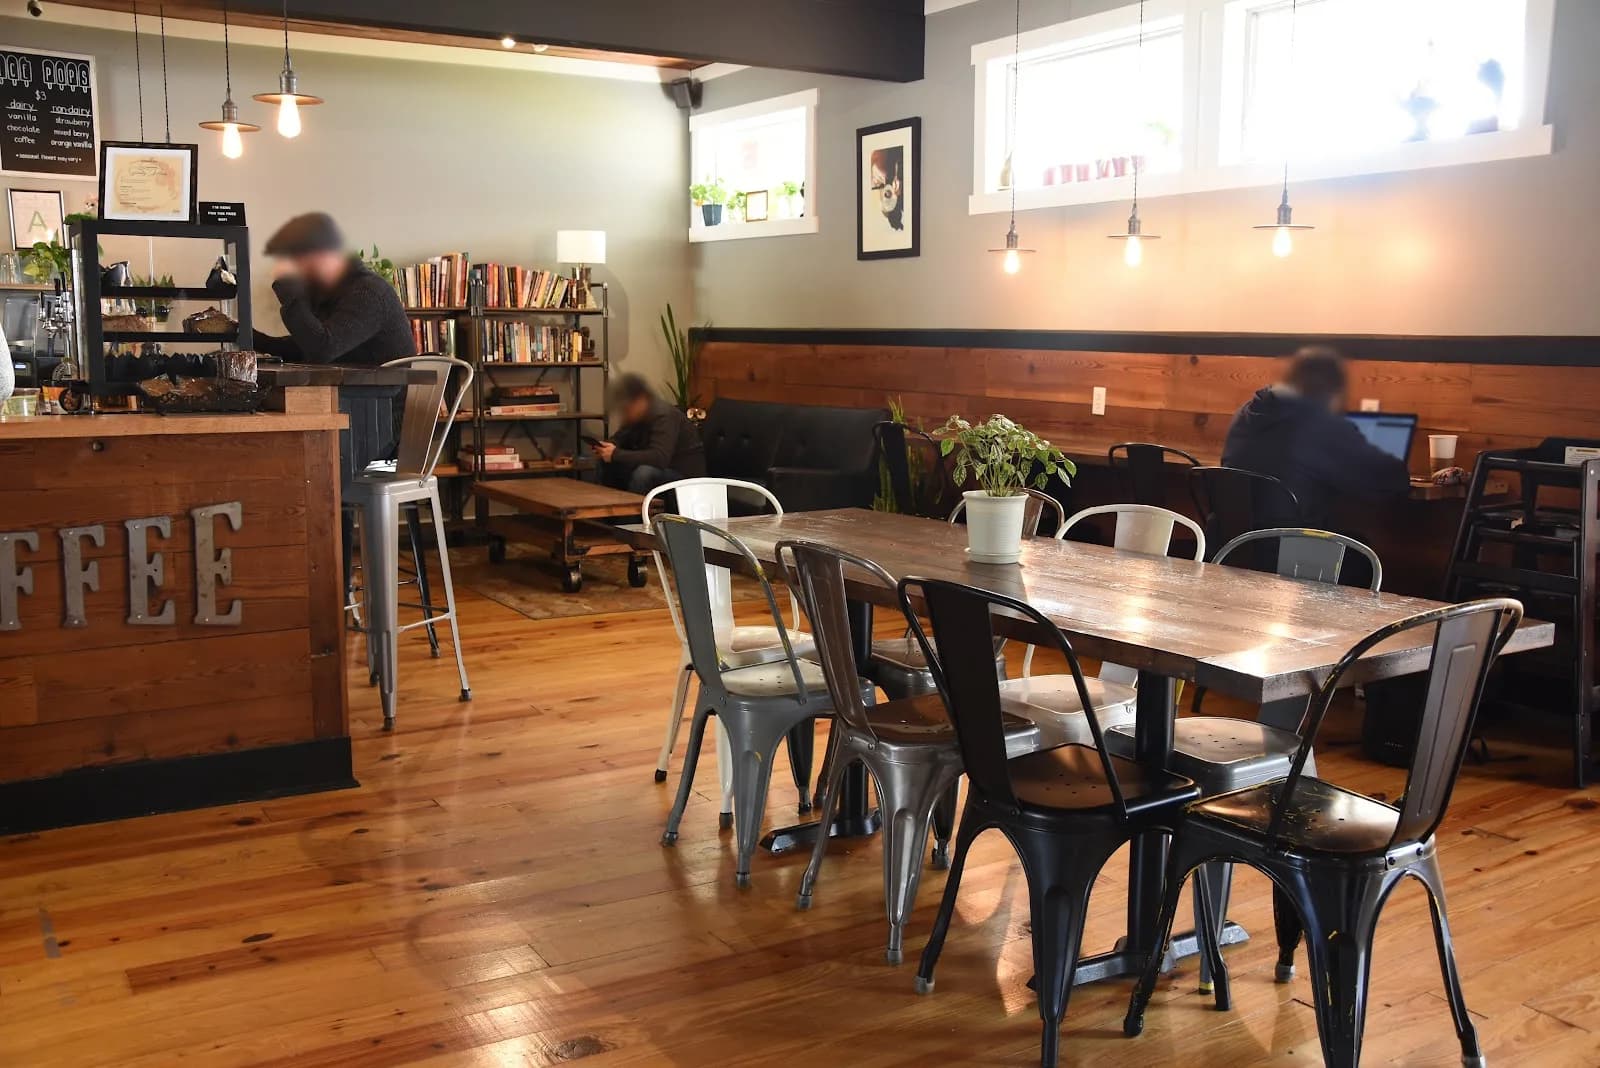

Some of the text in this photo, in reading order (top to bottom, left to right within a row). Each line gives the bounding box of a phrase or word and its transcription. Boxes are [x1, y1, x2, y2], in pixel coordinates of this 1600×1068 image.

[35, 89, 47, 101] $3
[10, 98, 34, 112] dairy
[7, 113, 37, 122] vanilla
[55, 116, 90, 128] strawberry
[6, 125, 41, 134] chocolate
[14, 136, 36, 145] coffee
[28, 210, 48, 233] A
[0, 501, 243, 631] FFEE
